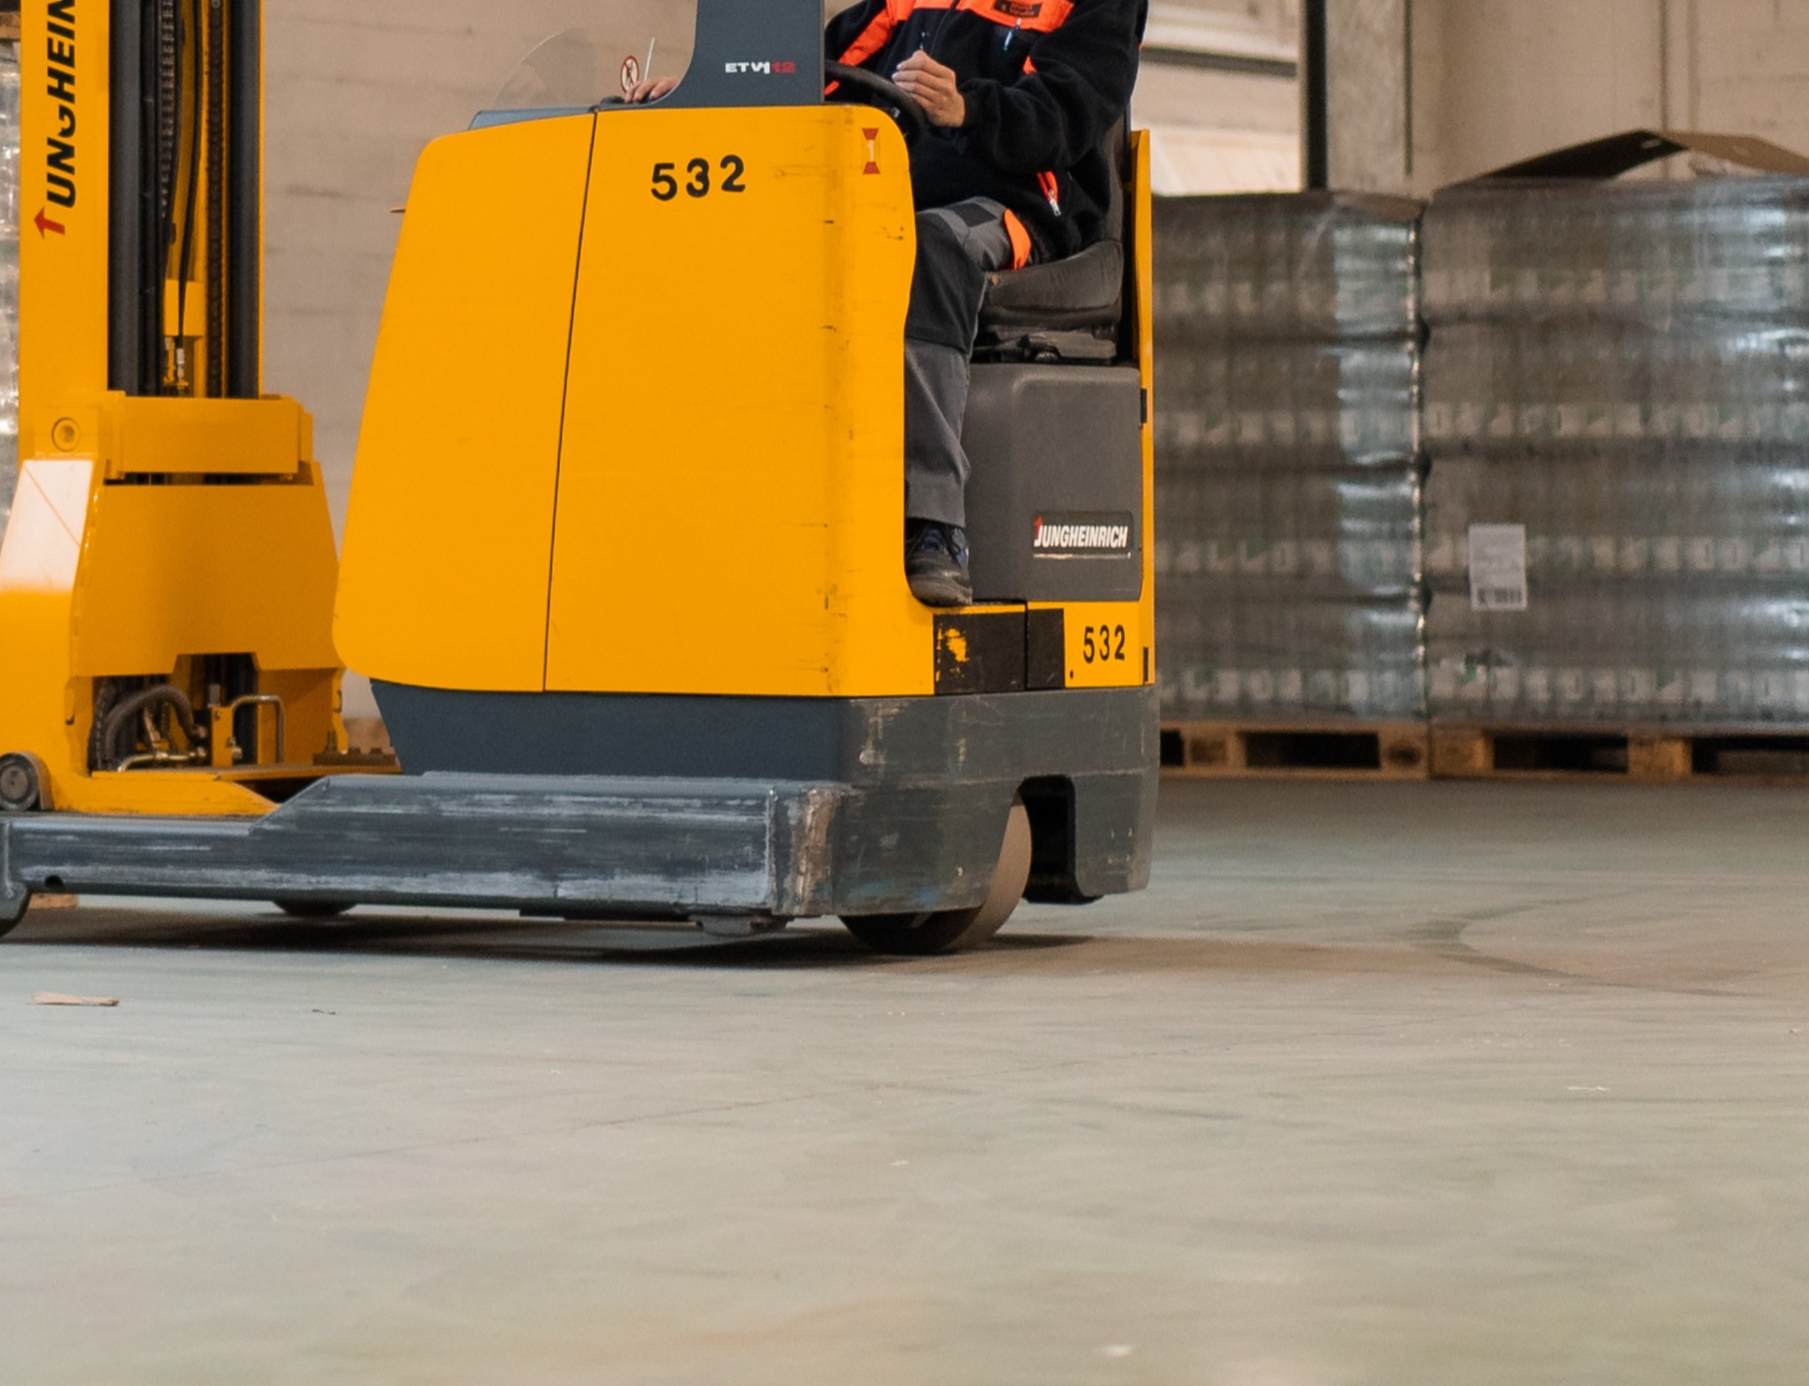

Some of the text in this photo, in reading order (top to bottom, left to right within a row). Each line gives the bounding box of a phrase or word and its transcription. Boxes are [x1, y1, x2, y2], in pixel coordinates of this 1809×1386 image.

[650, 154, 746, 202] 532
[1033, 518, 1129, 548] JUNGHEINRICH
[1082, 624, 1126, 664] 532
